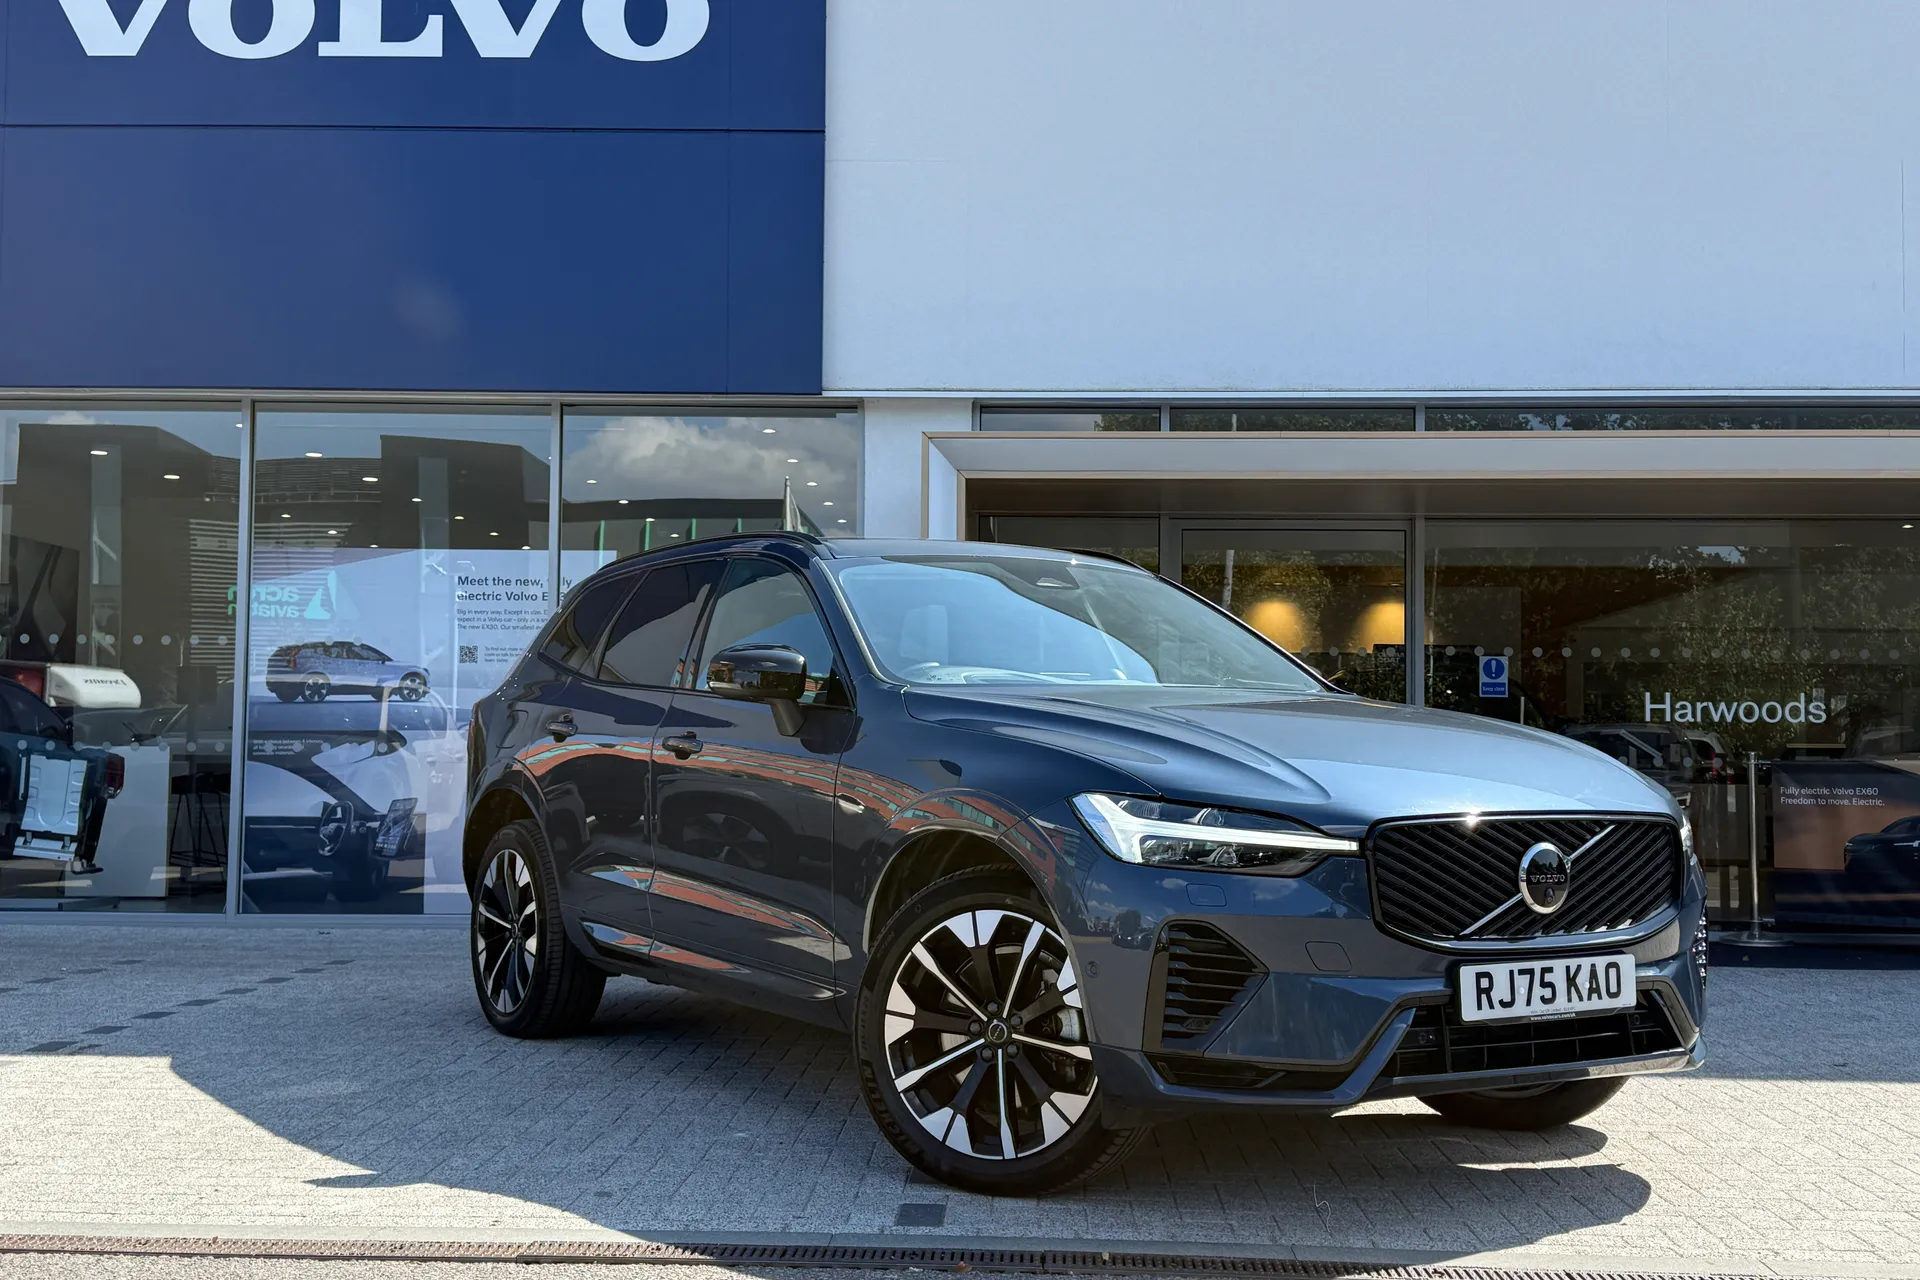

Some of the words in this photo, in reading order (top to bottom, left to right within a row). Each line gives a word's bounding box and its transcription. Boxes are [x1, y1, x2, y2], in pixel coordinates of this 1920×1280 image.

[60, 0, 711, 61] VOLVO
[457, 576, 489, 586] Meet
[492, 576, 512, 587] the
[515, 577, 544, 588] new,
[456, 591, 502, 601] electric
[505, 591, 538, 601] Volvo
[457, 608, 467, 616] Big
[504, 608, 523, 616] Except
[1644, 691, 1827, 724] Harwoods
[1780, 786, 1800, 796] Fully
[1801, 786, 1831, 795] electric
[1832, 787, 1855, 795] Volvo
[1856, 787, 1879, 796] EX60
[1780, 796, 1817, 805] Freedom
[1827, 798, 1851, 806] move.
[1852, 797, 1886, 806] Electric.
[1529, 874, 1566, 883] VOLVO
[1475, 966, 1557, 1011] RJ75
[1565, 961, 1622, 1003] KAO
